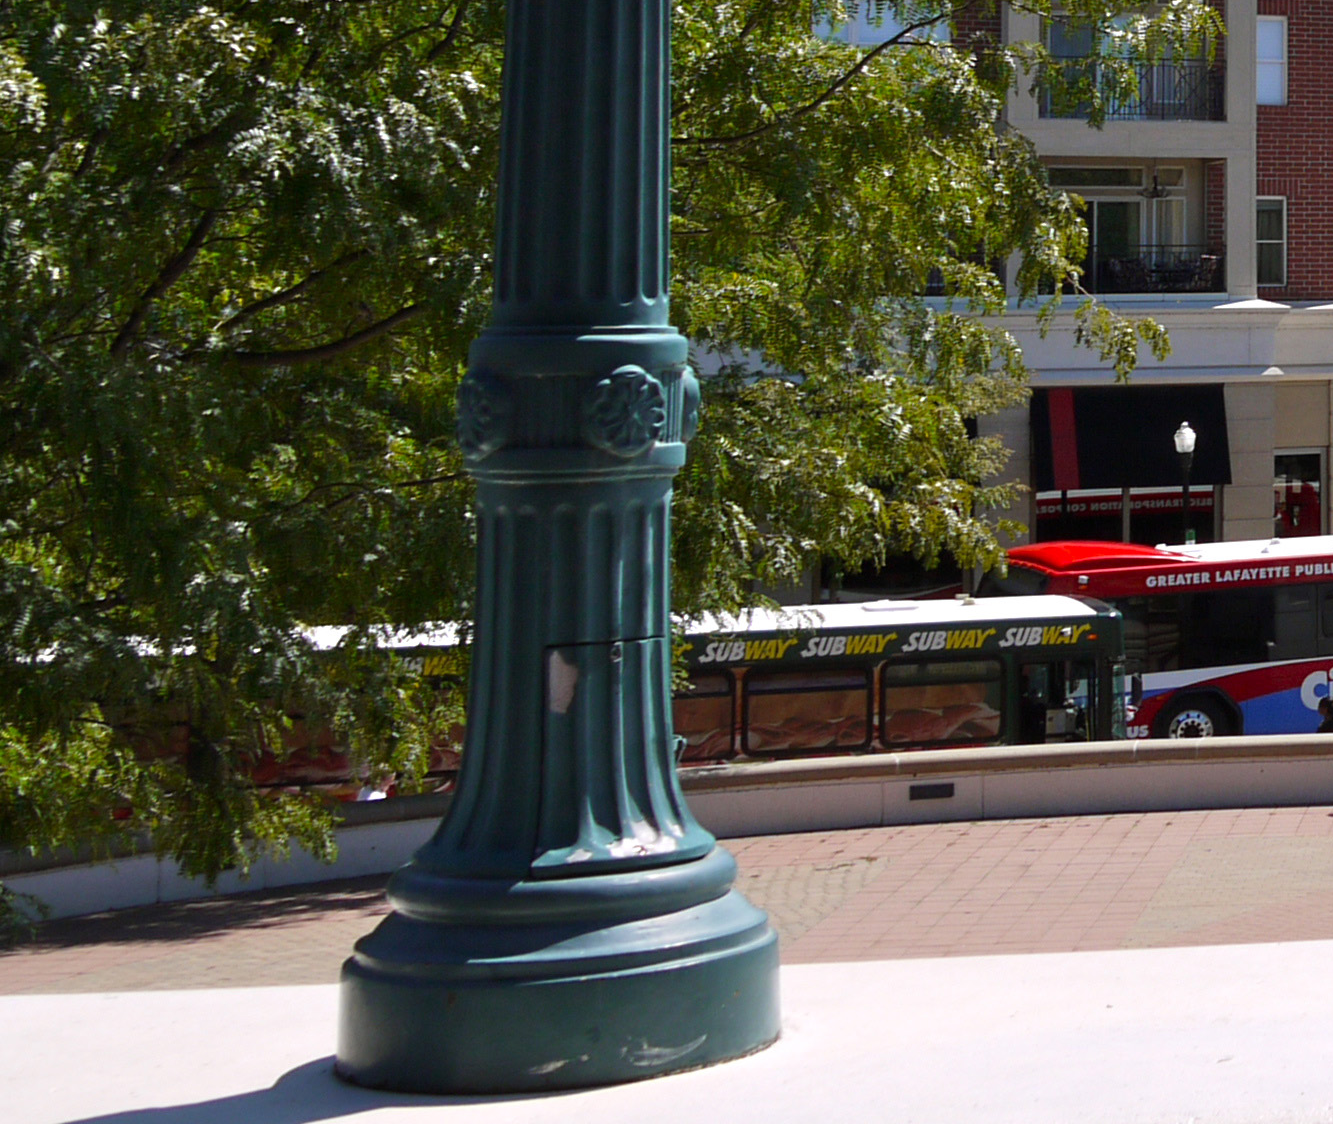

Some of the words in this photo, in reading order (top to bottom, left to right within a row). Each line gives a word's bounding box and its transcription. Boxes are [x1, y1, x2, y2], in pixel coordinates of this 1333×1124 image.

[1146, 572, 1210, 588] GREATER
[1215, 566, 1290, 582] LAFAYETTE
[801, 632, 898, 658] SUBWAY
[902, 628, 996, 652] SUBWAY
[999, 623, 1092, 648] SUBWAY
[698, 638, 798, 663] SUBWAY
